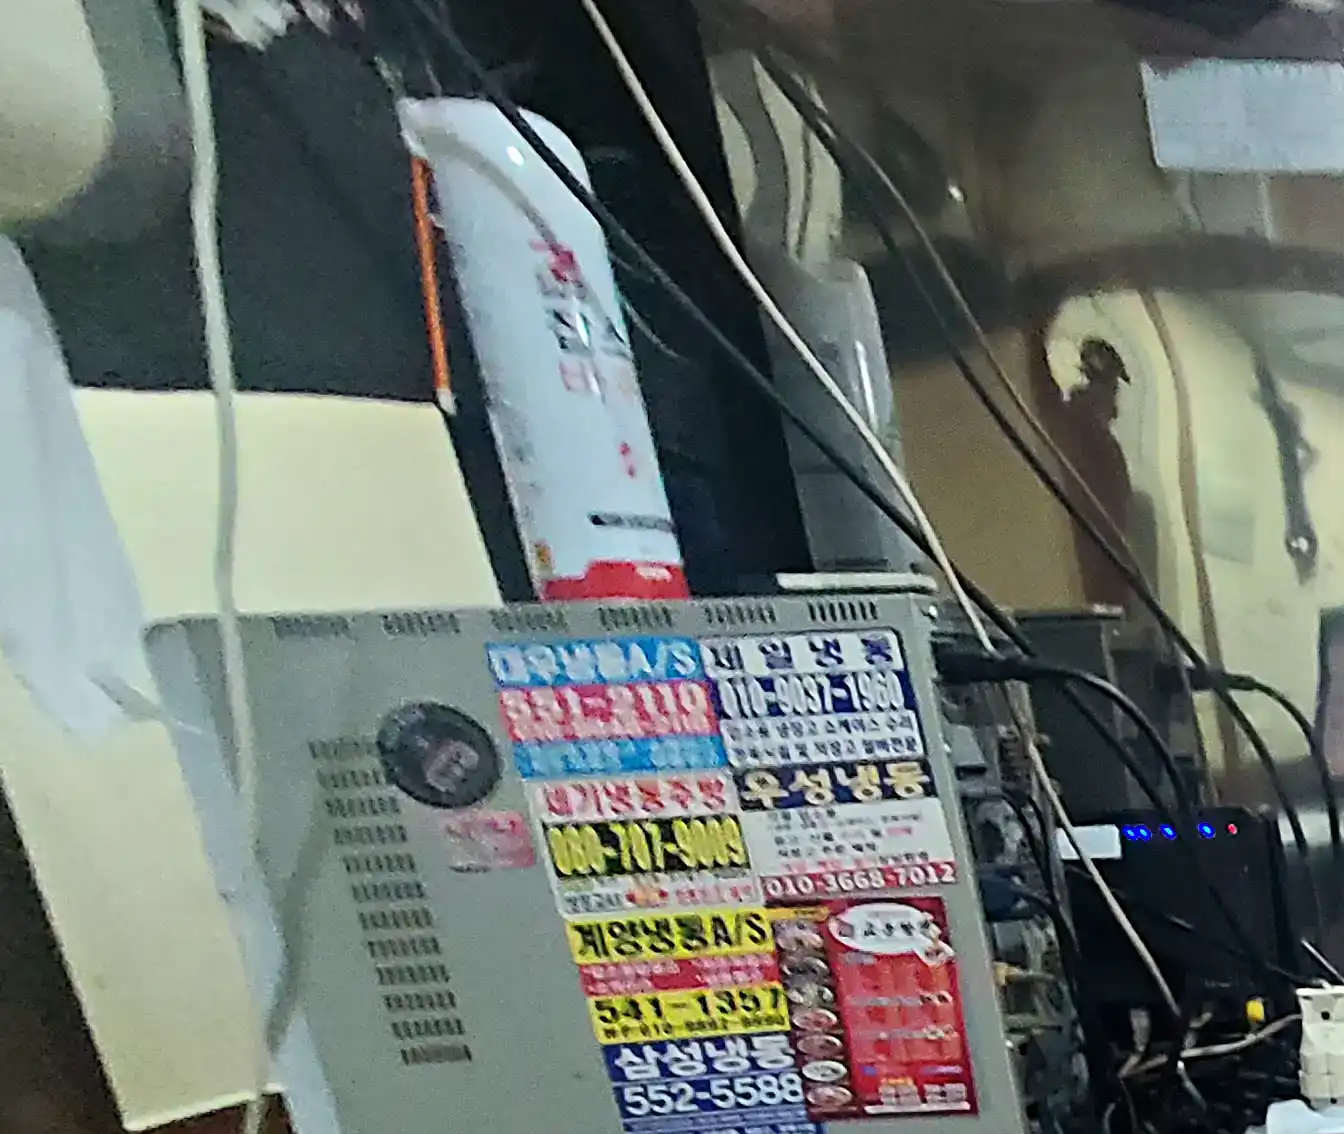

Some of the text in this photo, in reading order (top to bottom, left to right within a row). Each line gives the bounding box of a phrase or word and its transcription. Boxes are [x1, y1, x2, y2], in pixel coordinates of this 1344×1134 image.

[766, 867, 956, 894] 010-3668-7012
[615, 1034, 796, 1081] 삼성냉동
[623, 1072, 804, 1117] 552-5588
